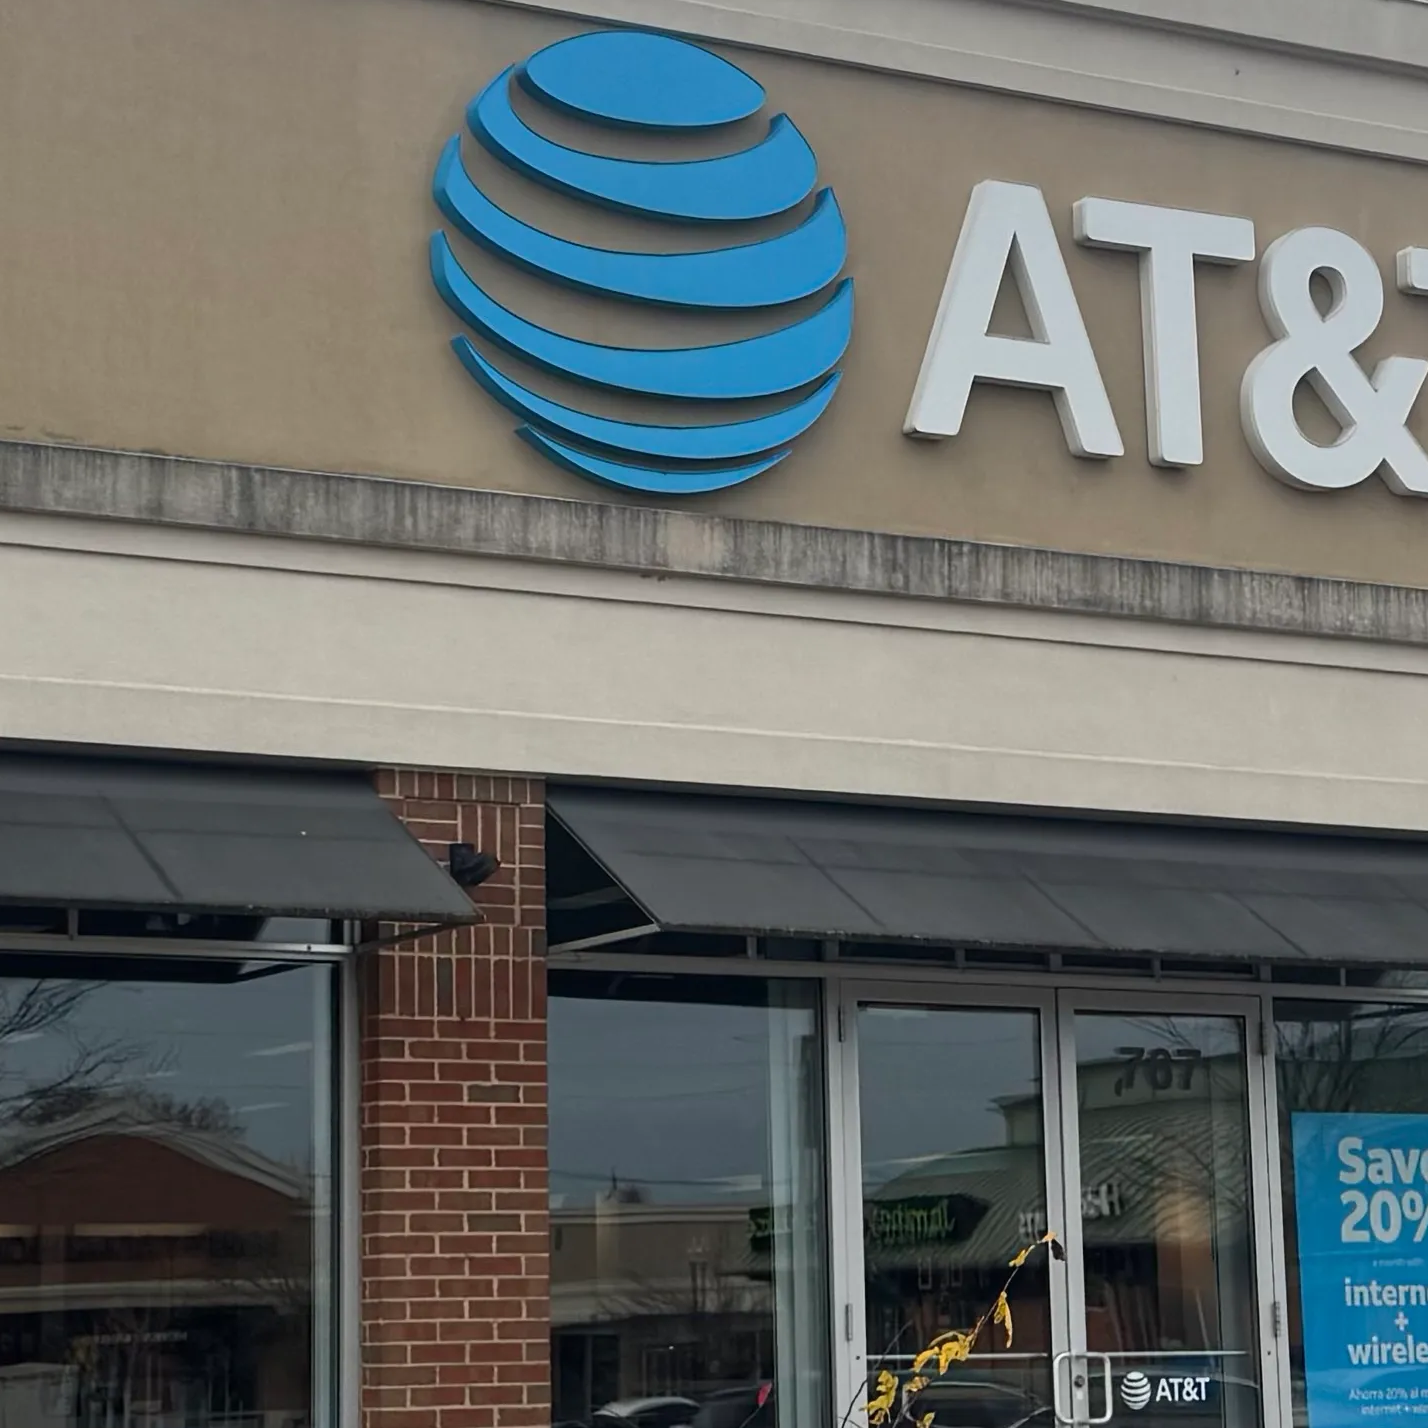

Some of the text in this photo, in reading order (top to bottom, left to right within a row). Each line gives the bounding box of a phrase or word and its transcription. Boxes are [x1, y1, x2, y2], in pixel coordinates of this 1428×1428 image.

[1394, 1312, 1409, 1331] +
[1156, 1377, 1209, 1402] AT&T
[1348, 1388, 1384, 1400] Ahorra
[1361, 1403, 1402, 1416] internet
